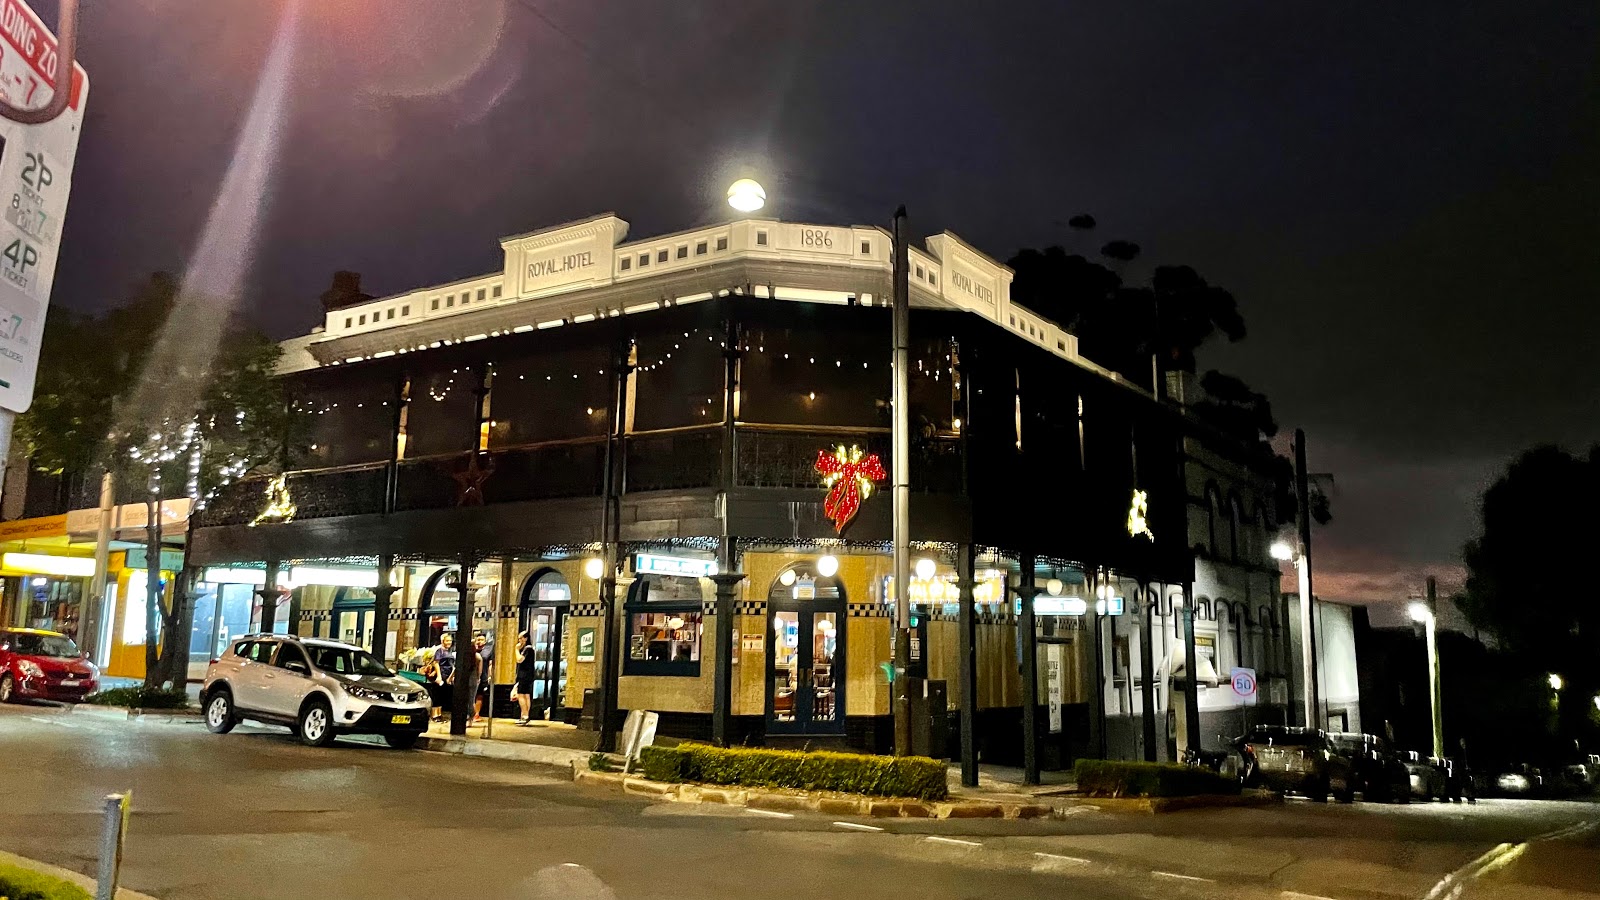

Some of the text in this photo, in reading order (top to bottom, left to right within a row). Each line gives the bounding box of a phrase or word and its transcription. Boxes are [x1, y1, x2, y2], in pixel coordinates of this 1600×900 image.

[21, 152, 53, 192] 2P
[12, 193, 20, 209] 8
[801, 229, 833, 248] 1886
[4, 239, 37, 273] 4P
[4, 266, 28, 288] TICKET
[952, 269, 995, 306] ROYAL HOTEL
[1236, 678, 1251, 690] 50
